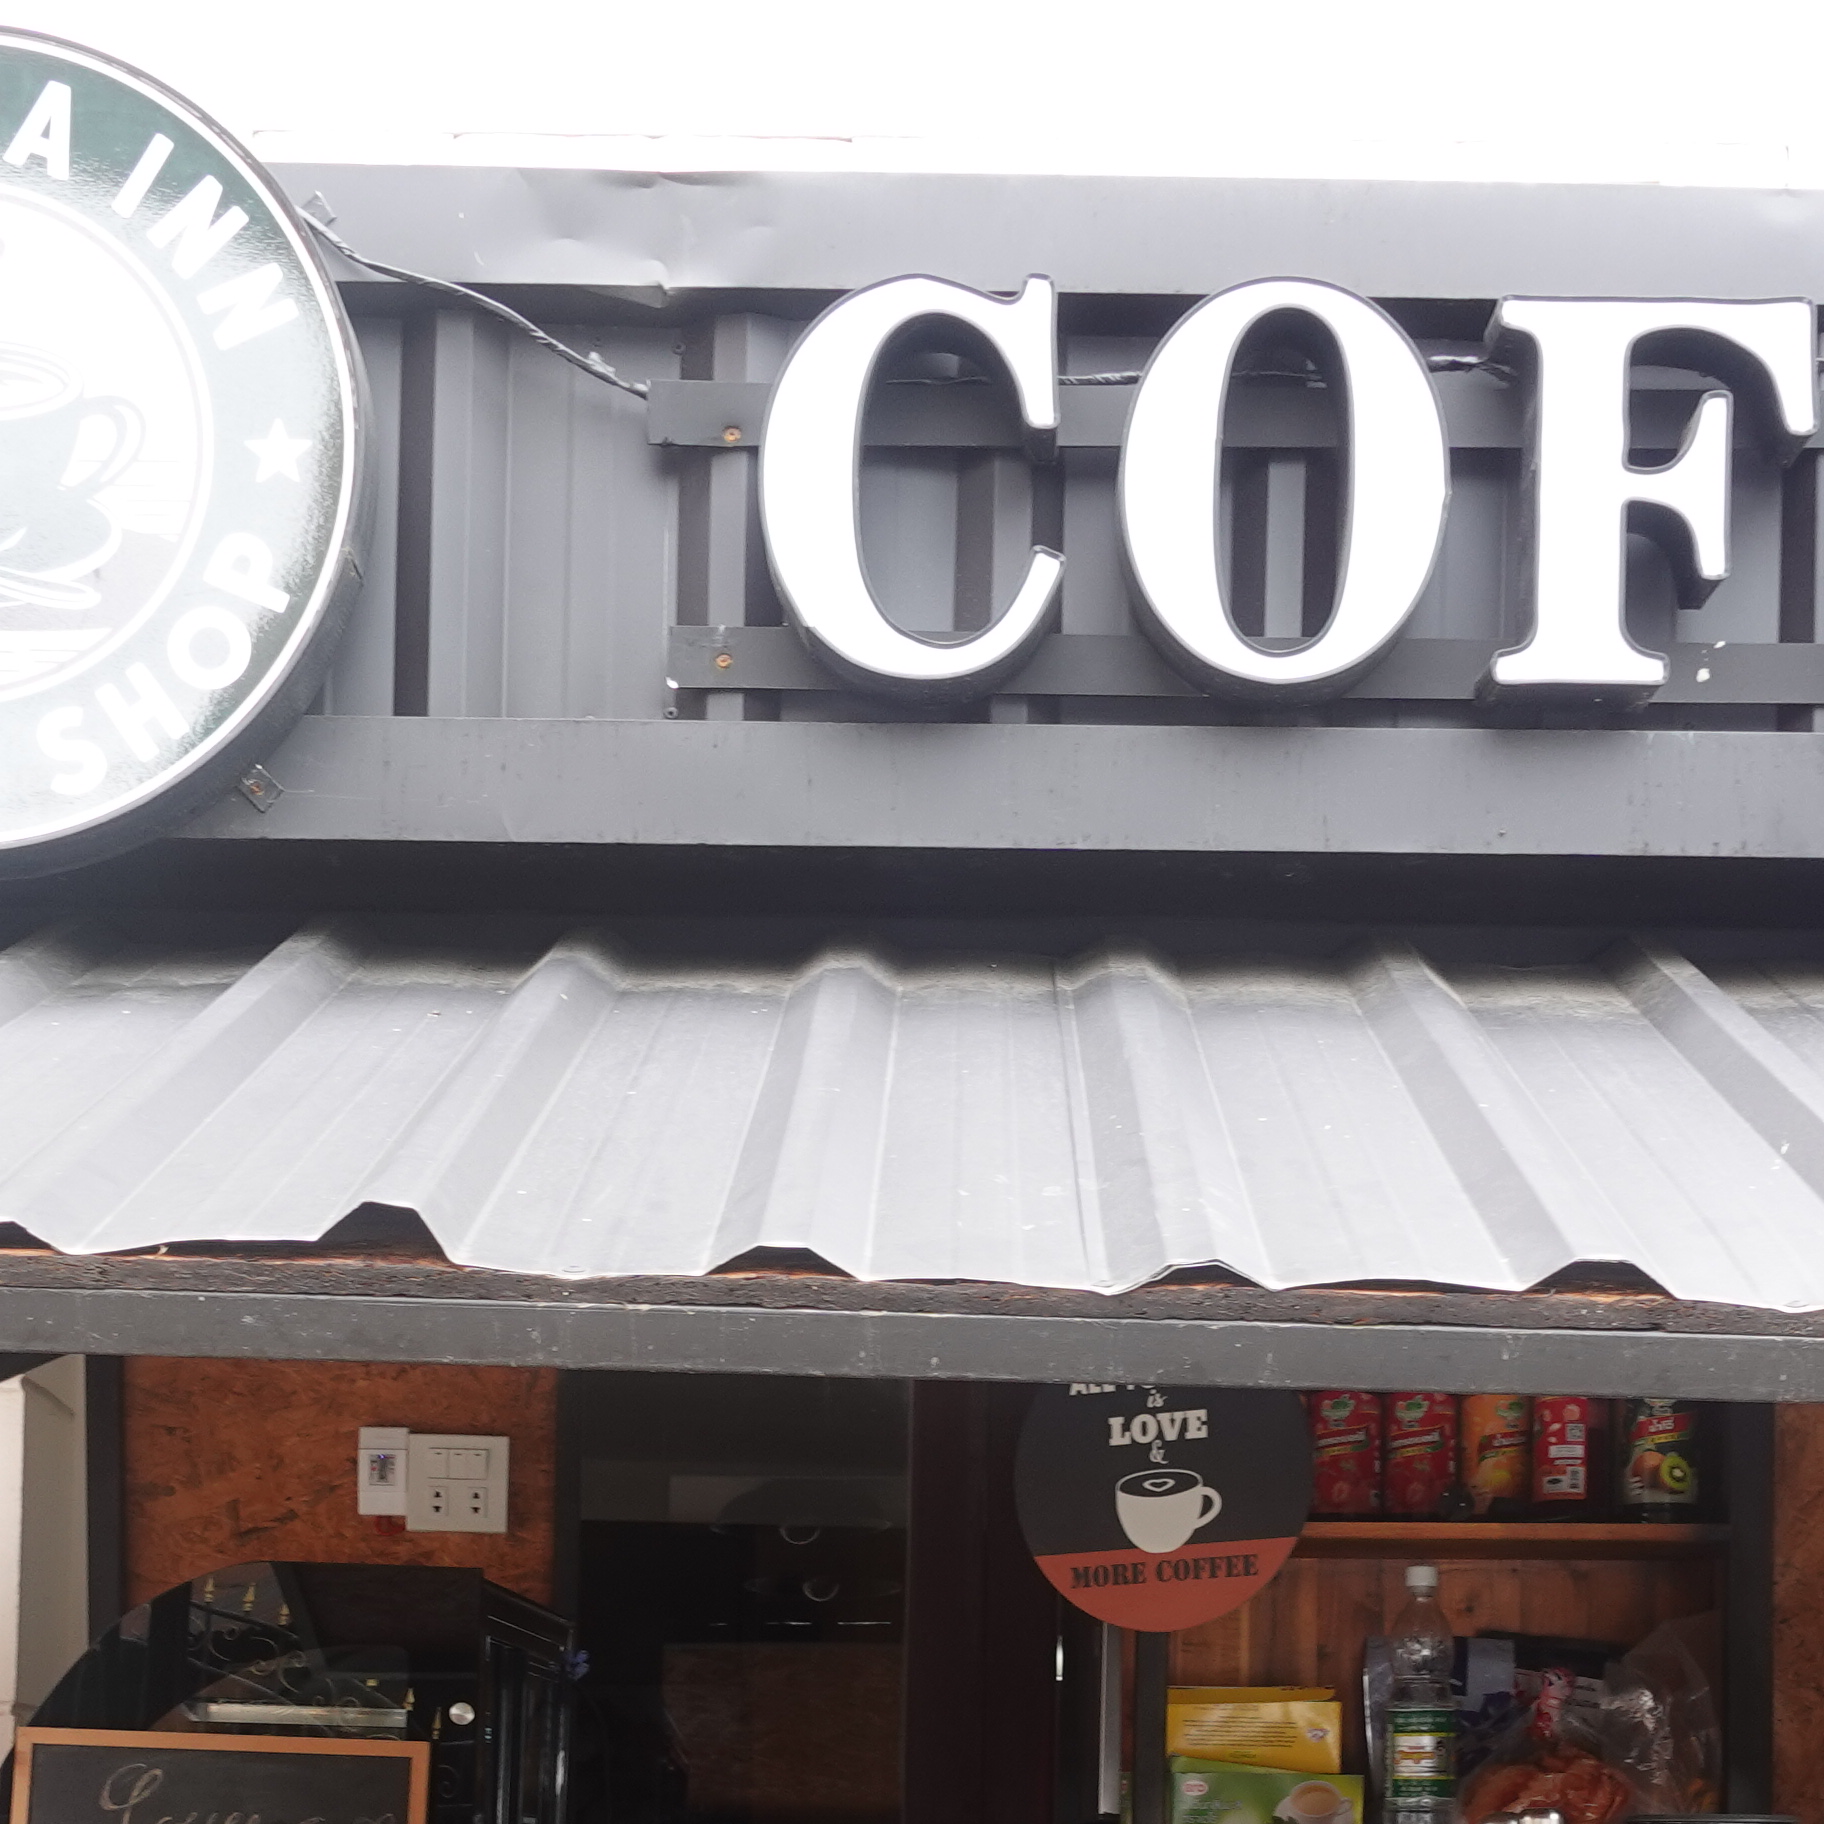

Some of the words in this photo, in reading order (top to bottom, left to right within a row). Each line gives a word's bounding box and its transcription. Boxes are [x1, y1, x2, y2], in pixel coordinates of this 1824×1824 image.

[111, 132, 300, 352] INN
[34, 530, 292, 802] SHOP
[1146, 1389, 1168, 1408] is
[1108, 1409, 1209, 1446] LOVE
[1149, 1439, 1169, 1464] &
[1070, 1562, 1147, 1589] MORE
[1155, 1554, 1259, 1583] COFFEE
